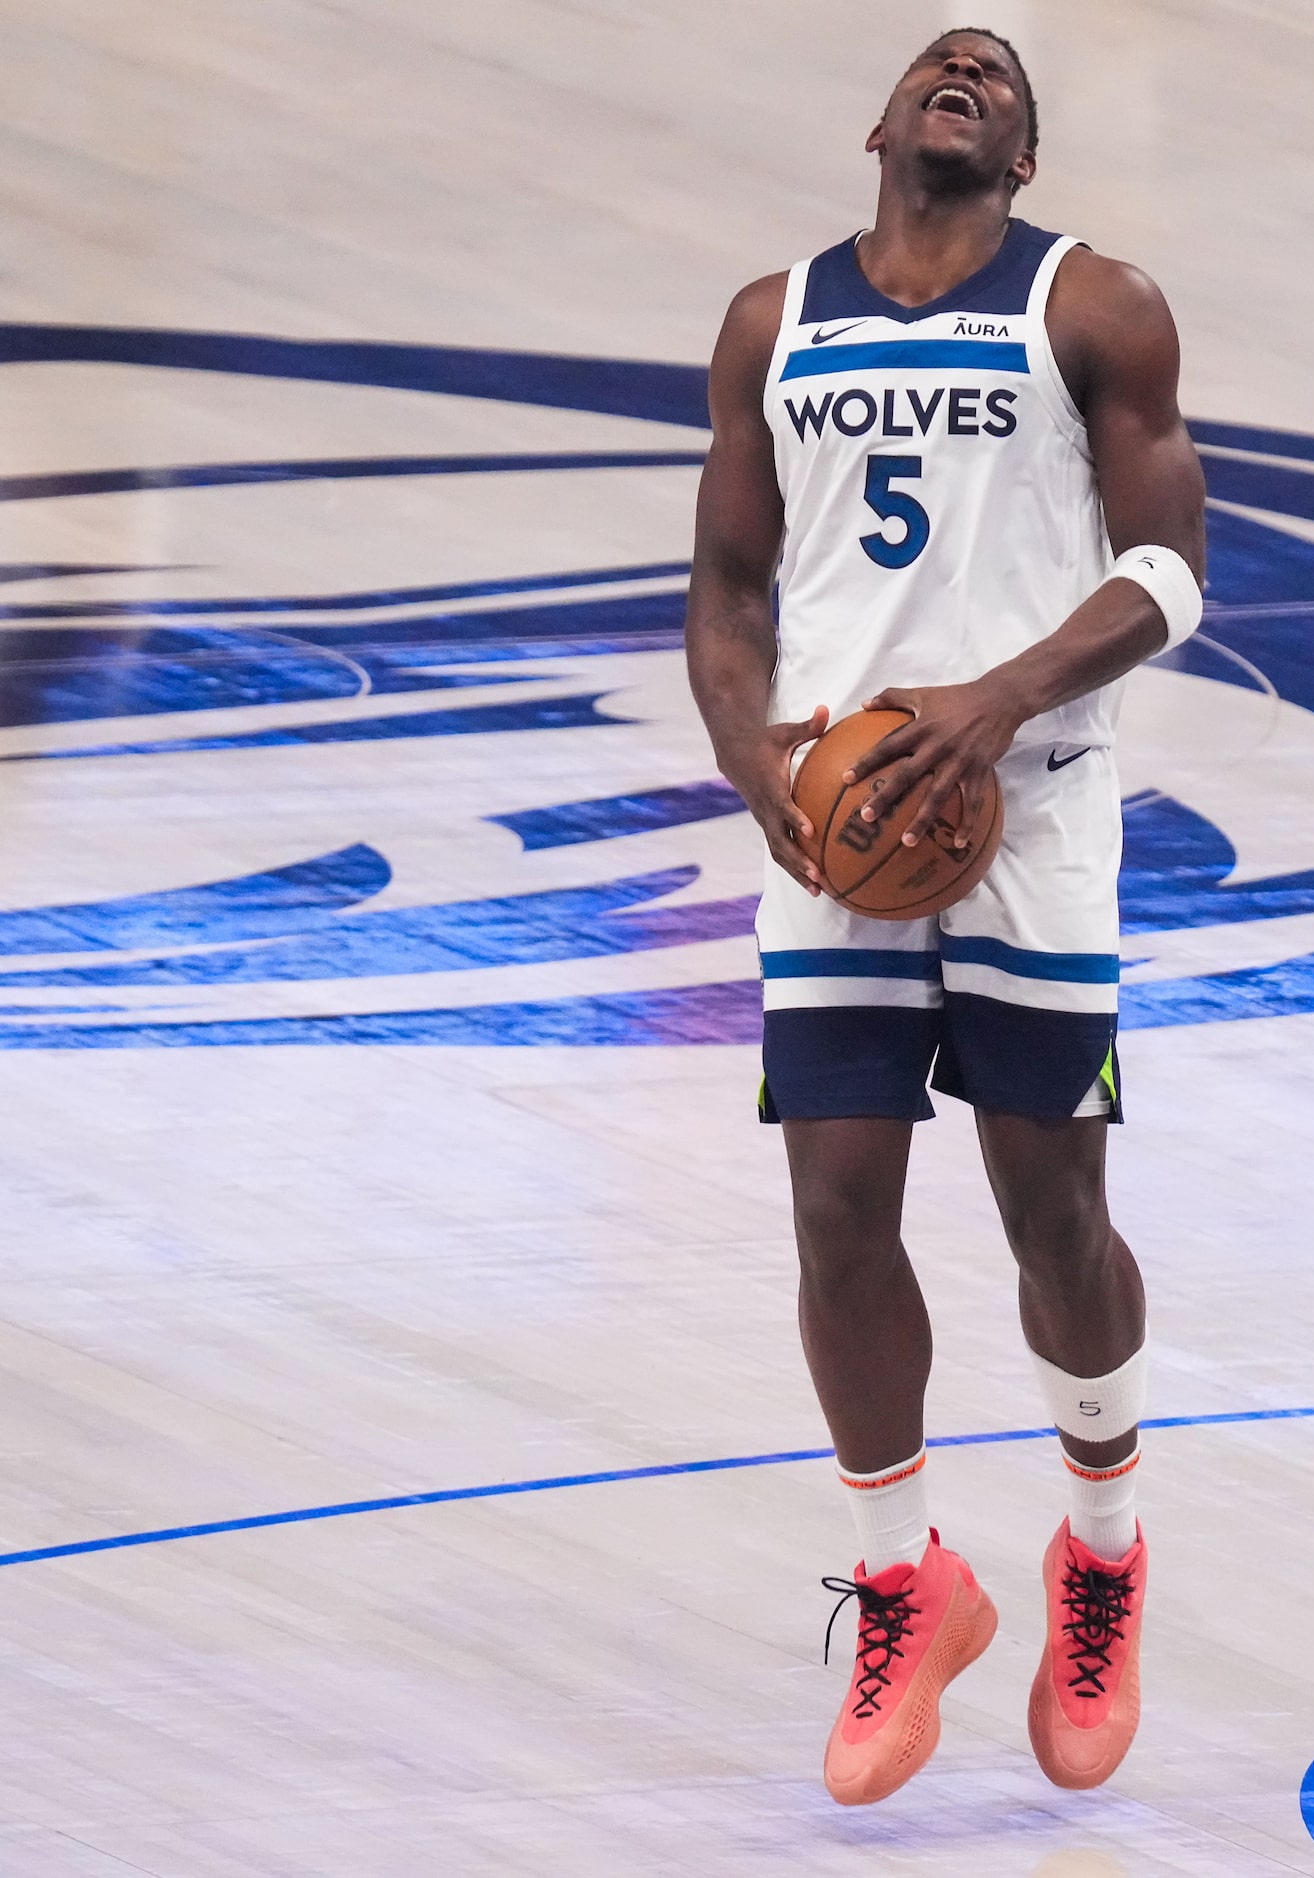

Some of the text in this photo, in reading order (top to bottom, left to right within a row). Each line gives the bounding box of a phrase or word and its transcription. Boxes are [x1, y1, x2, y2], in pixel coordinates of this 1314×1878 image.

[784, 388, 1018, 445] WOLVES
[859, 455, 930, 570] 5
[1079, 1400, 1101, 1417] 5
